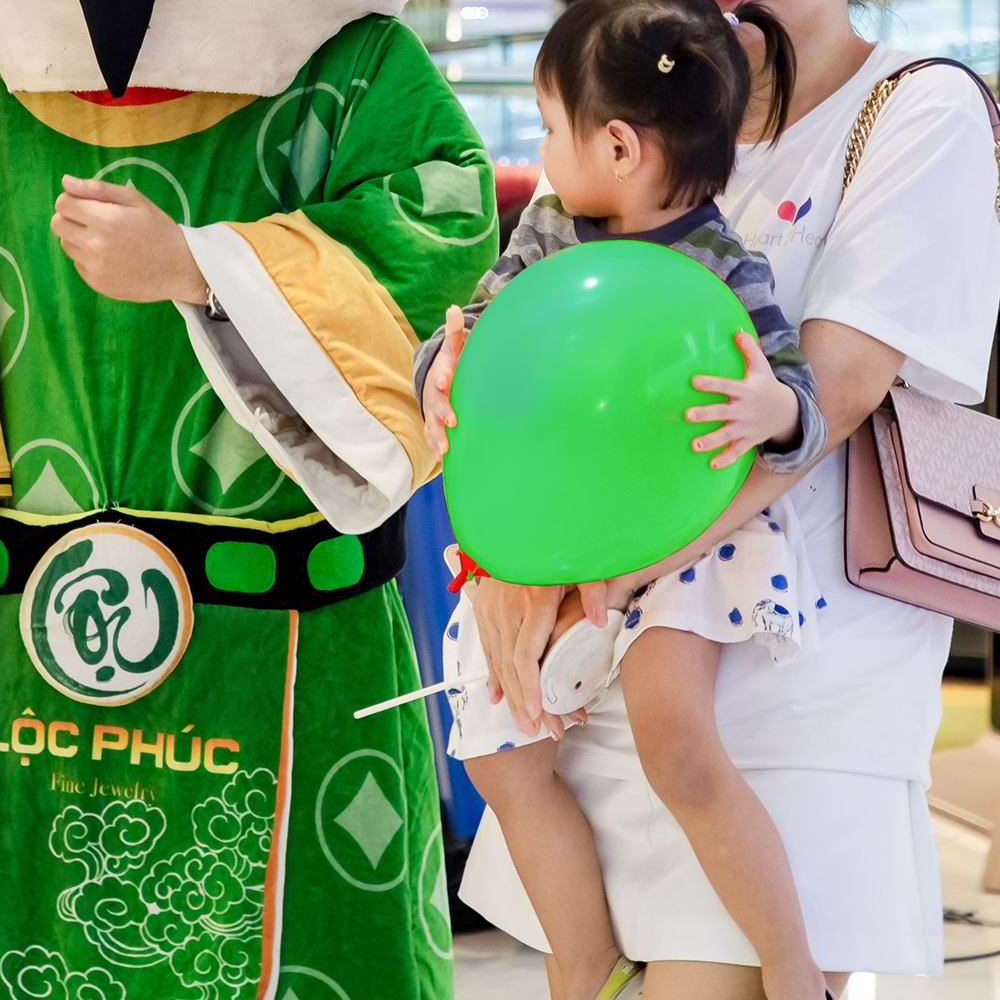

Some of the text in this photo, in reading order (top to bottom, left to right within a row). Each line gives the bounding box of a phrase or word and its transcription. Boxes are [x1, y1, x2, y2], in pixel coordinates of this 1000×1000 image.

[91, 724, 240, 775] PHÚC
[51, 773, 156, 807] Fine Jewelry
